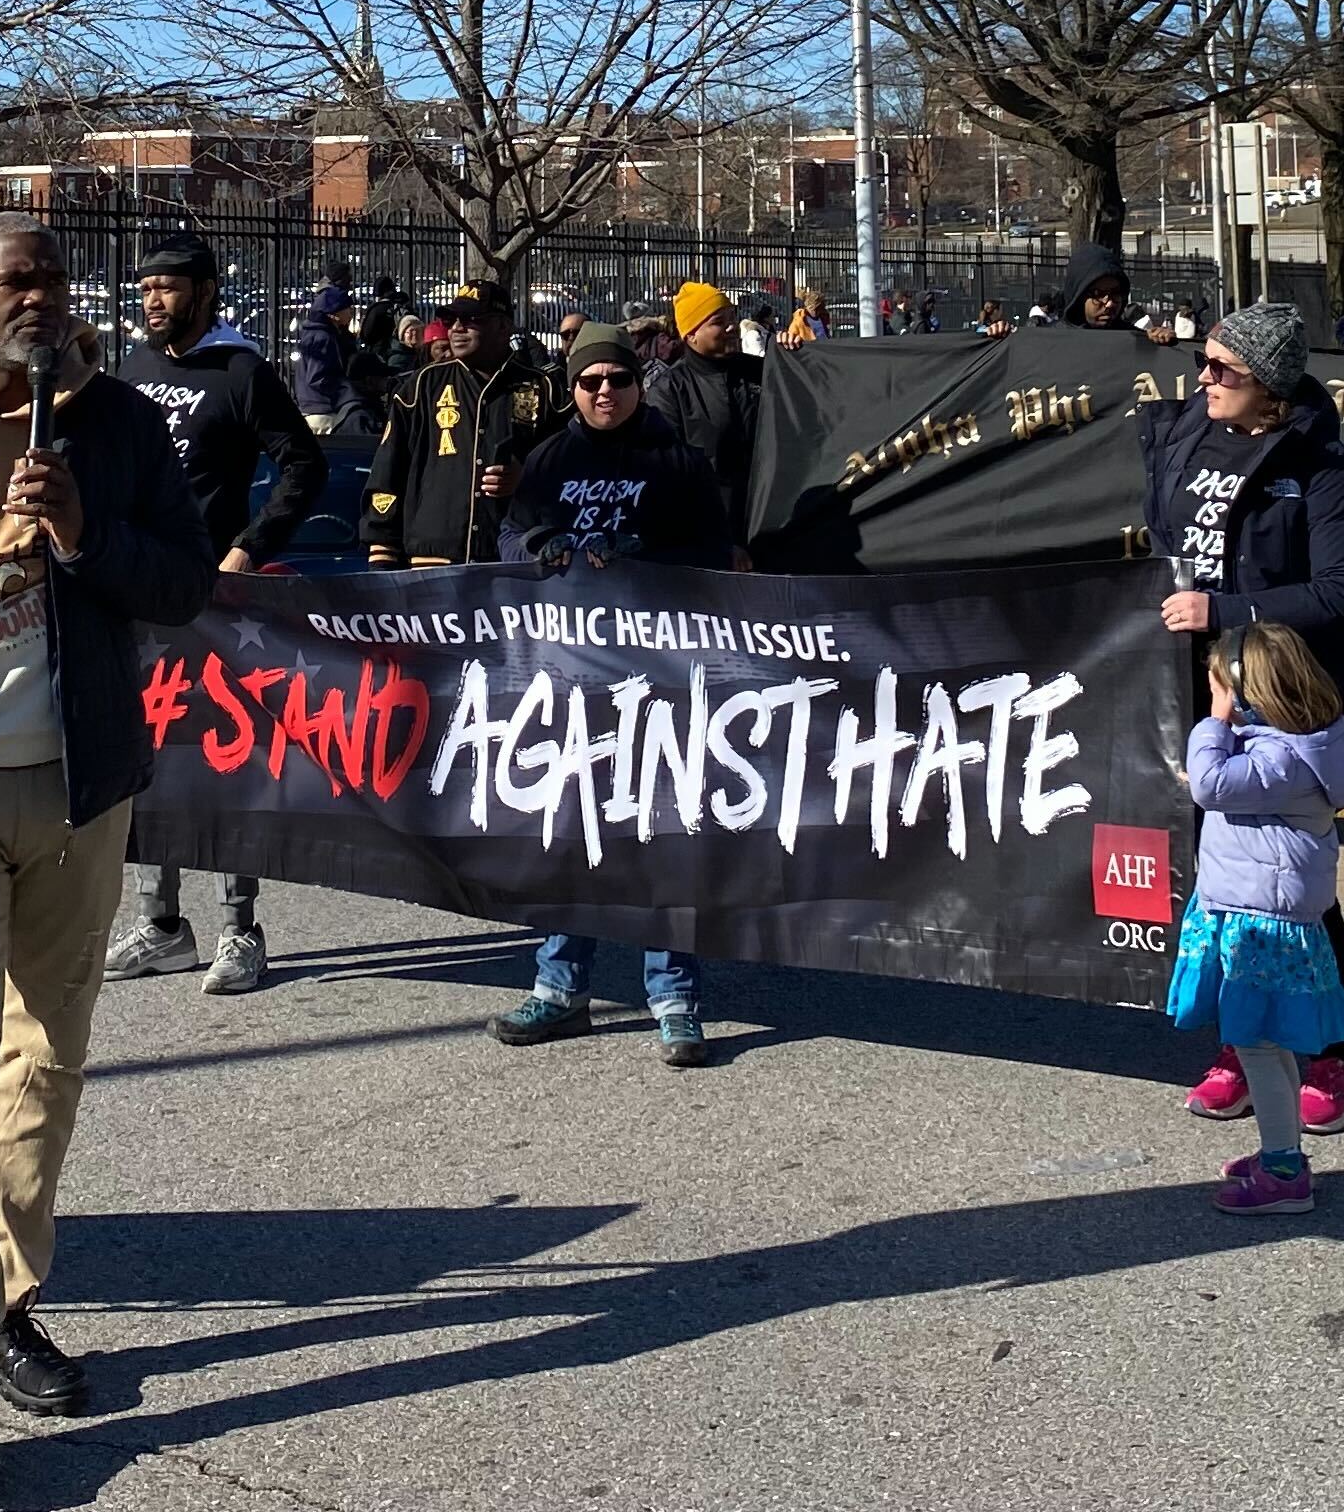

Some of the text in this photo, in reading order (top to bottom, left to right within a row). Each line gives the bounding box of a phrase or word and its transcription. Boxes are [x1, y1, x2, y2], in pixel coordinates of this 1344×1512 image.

[559, 479, 647, 508] RACISM
[572, 506, 627, 531] IS A
[1194, 500, 1229, 526] IS
[308, 602, 852, 662] RACISM IS A PUBLIC HEALTH ISSUE.
[142, 651, 1093, 870] #STAND AGAINST HATE
[1102, 852, 1157, 890] AHF
[1102, 921, 1167, 952] .ORG
